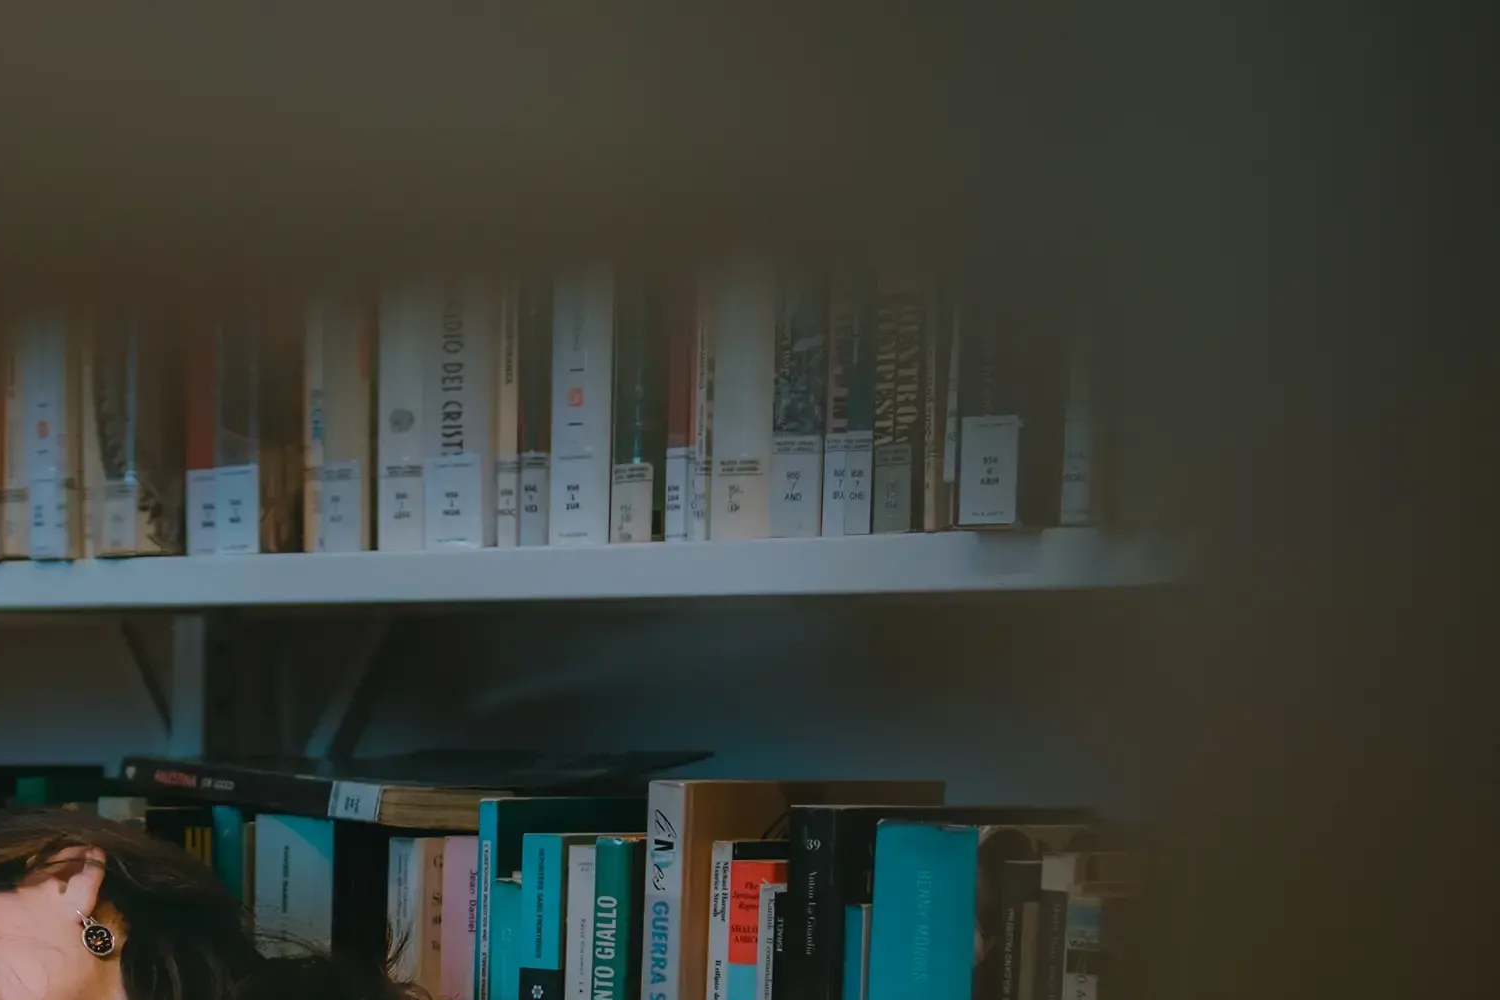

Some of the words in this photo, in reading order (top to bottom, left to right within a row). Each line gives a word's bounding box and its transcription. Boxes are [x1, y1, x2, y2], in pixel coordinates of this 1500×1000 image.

[442, 362, 464, 392] DEI
[441, 400, 464, 456] CRIST
[784, 493, 802, 502] AND
[806, 838, 821, 851] 39
[469, 869, 478, 896] Jean
[721, 860, 729, 890] Michael
[807, 871, 818, 895] Anton
[914, 869, 932, 920] BENNY
[468, 900, 477, 933] Daniel
[596, 895, 618, 960] GIALLO
[650, 900, 670, 984] GUERRA
[776, 917, 784, 951] ISRAELE
[911, 923, 930, 982] MORRIS
